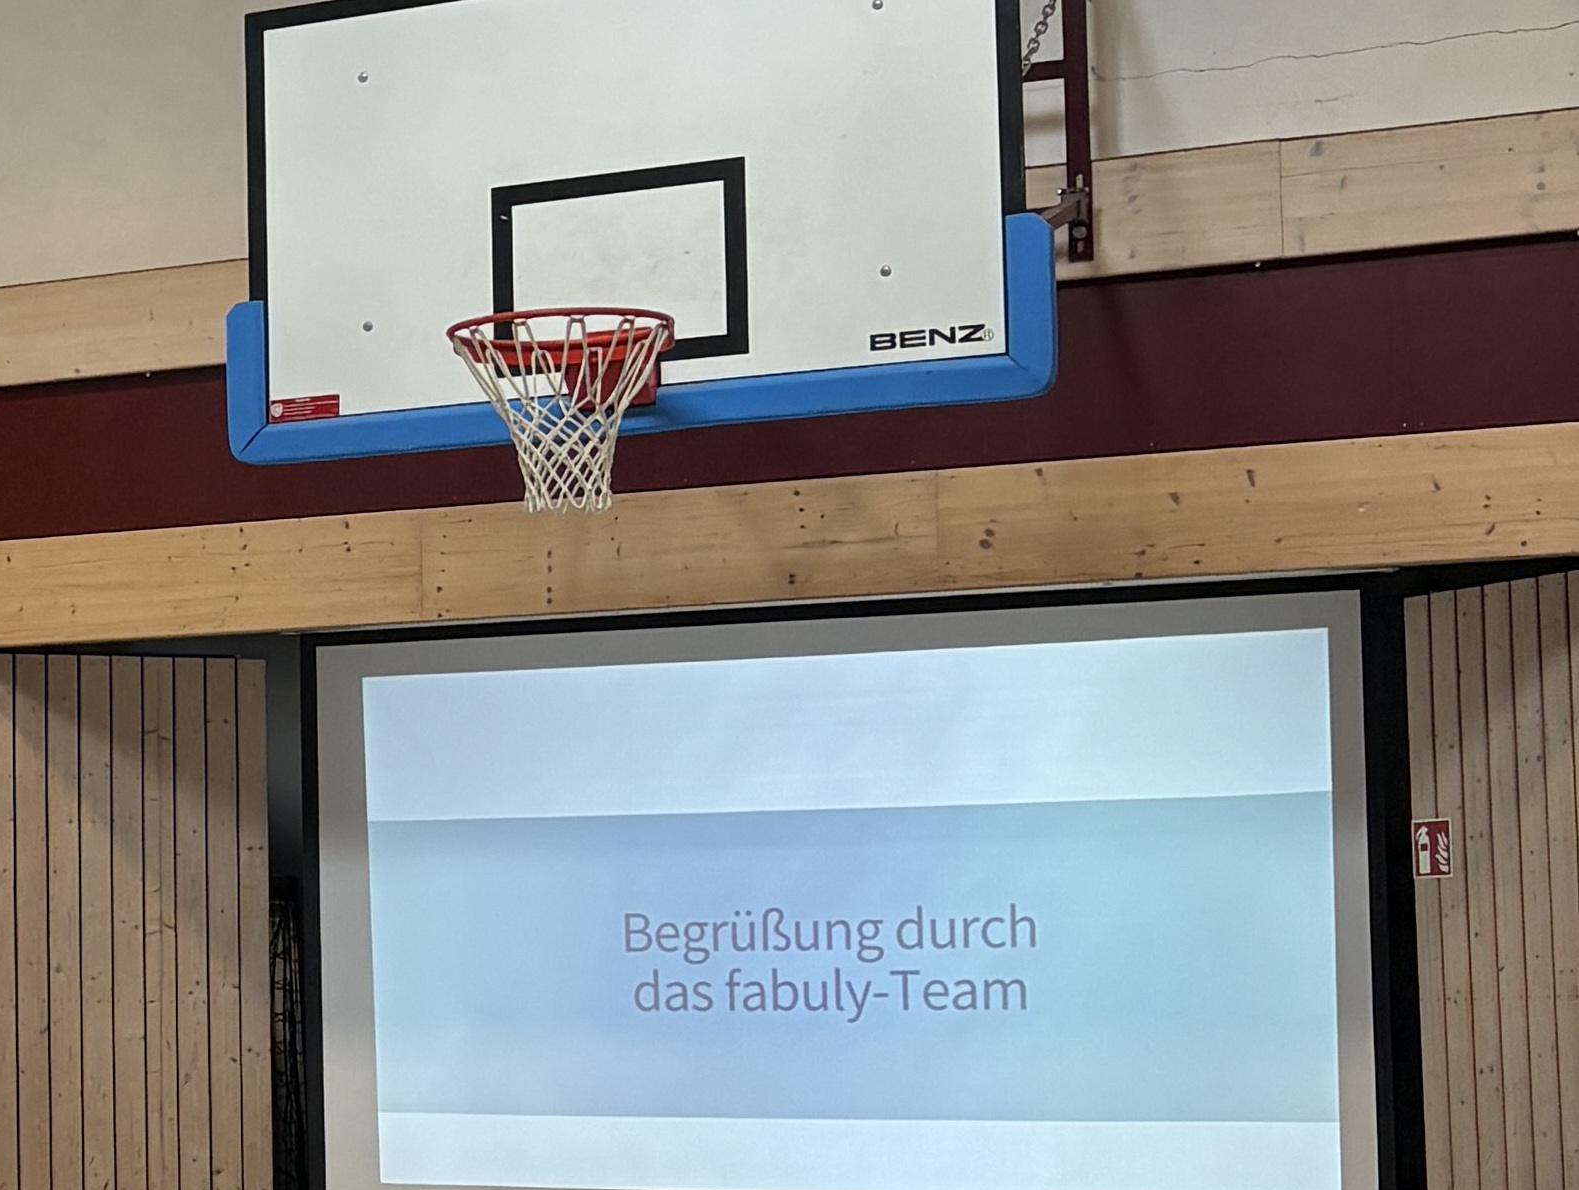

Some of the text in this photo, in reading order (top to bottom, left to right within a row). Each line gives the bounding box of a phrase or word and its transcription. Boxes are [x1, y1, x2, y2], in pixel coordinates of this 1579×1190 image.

[870, 324, 986, 351] BENZ
[623, 903, 1037, 965] Begrüßung durch
[633, 967, 1027, 1023] das fabuly-Team
